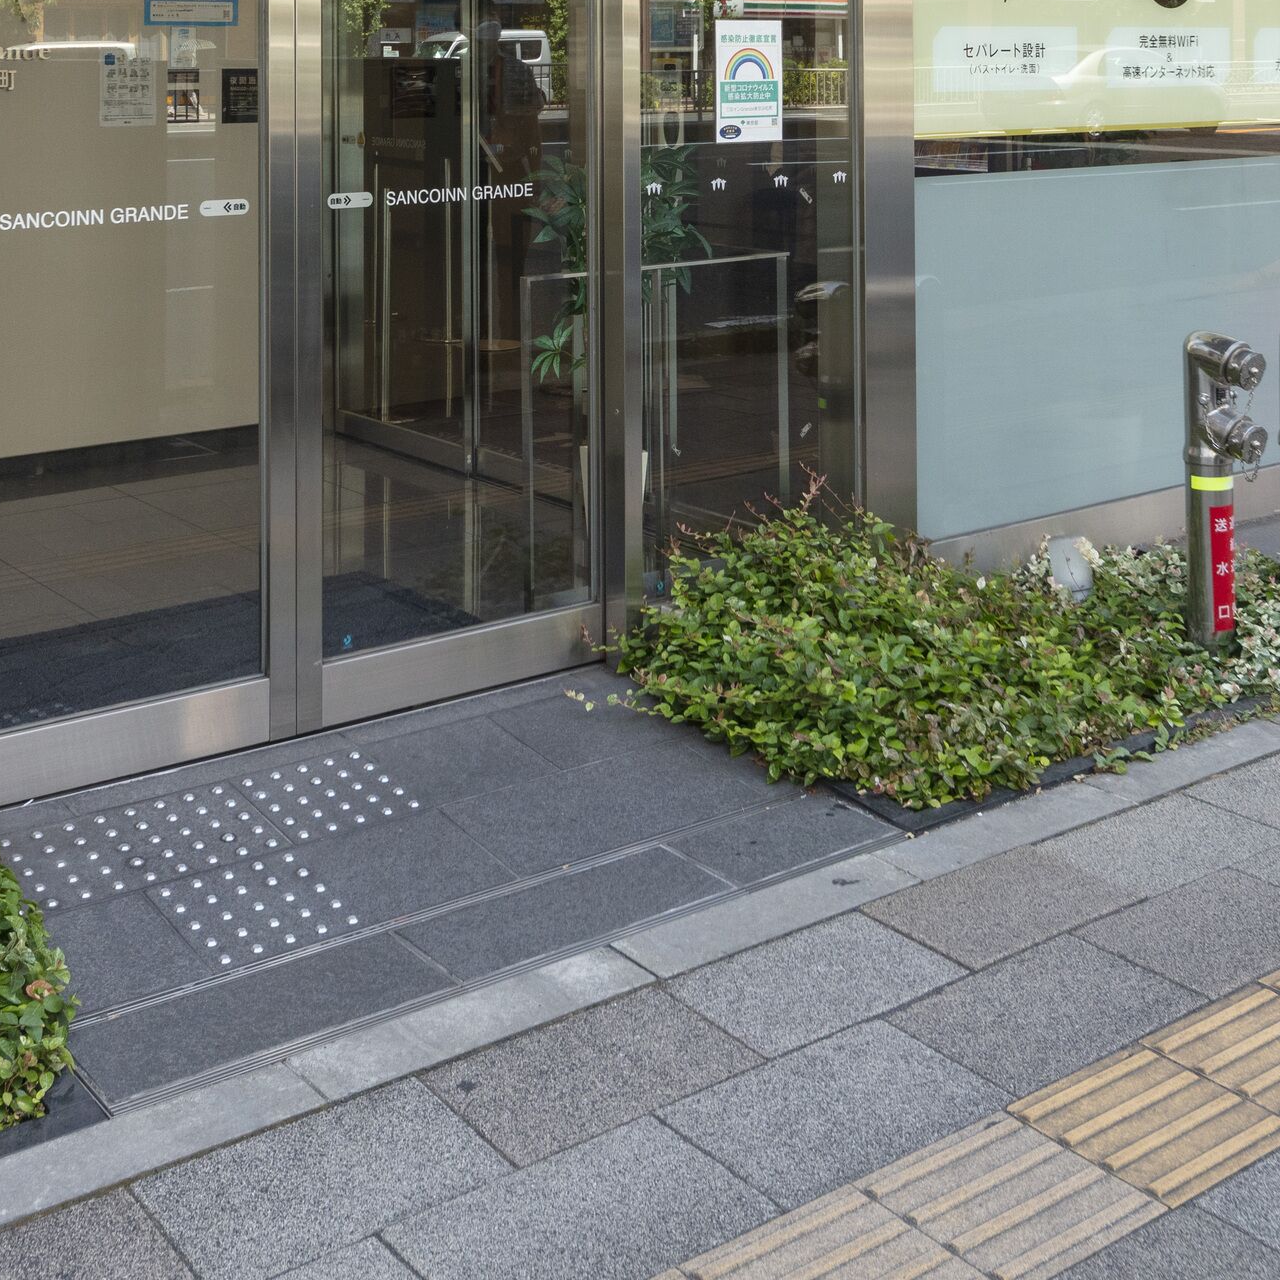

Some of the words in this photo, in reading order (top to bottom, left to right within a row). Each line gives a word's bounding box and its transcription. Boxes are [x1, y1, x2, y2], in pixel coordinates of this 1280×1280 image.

[721, 34, 777, 43] 感染防止徹底宣言
[1139, 35, 1199, 48] 完全無料WiFi
[963, 42, 1046, 58] セパレート設計
[1167, 52, 1172, 62] &
[1122, 65, 1215, 79] 高速インターネット対応
[724, 84, 774, 92] 新型コロナウイルス
[386, 187, 467, 206] SANCOINN
[472, 183, 533, 200] GRANDE
[0, 208, 104, 230] SANCOINN
[110, 203, 189, 224] GRANDE
[1214, 518, 1230, 619] 送水口
